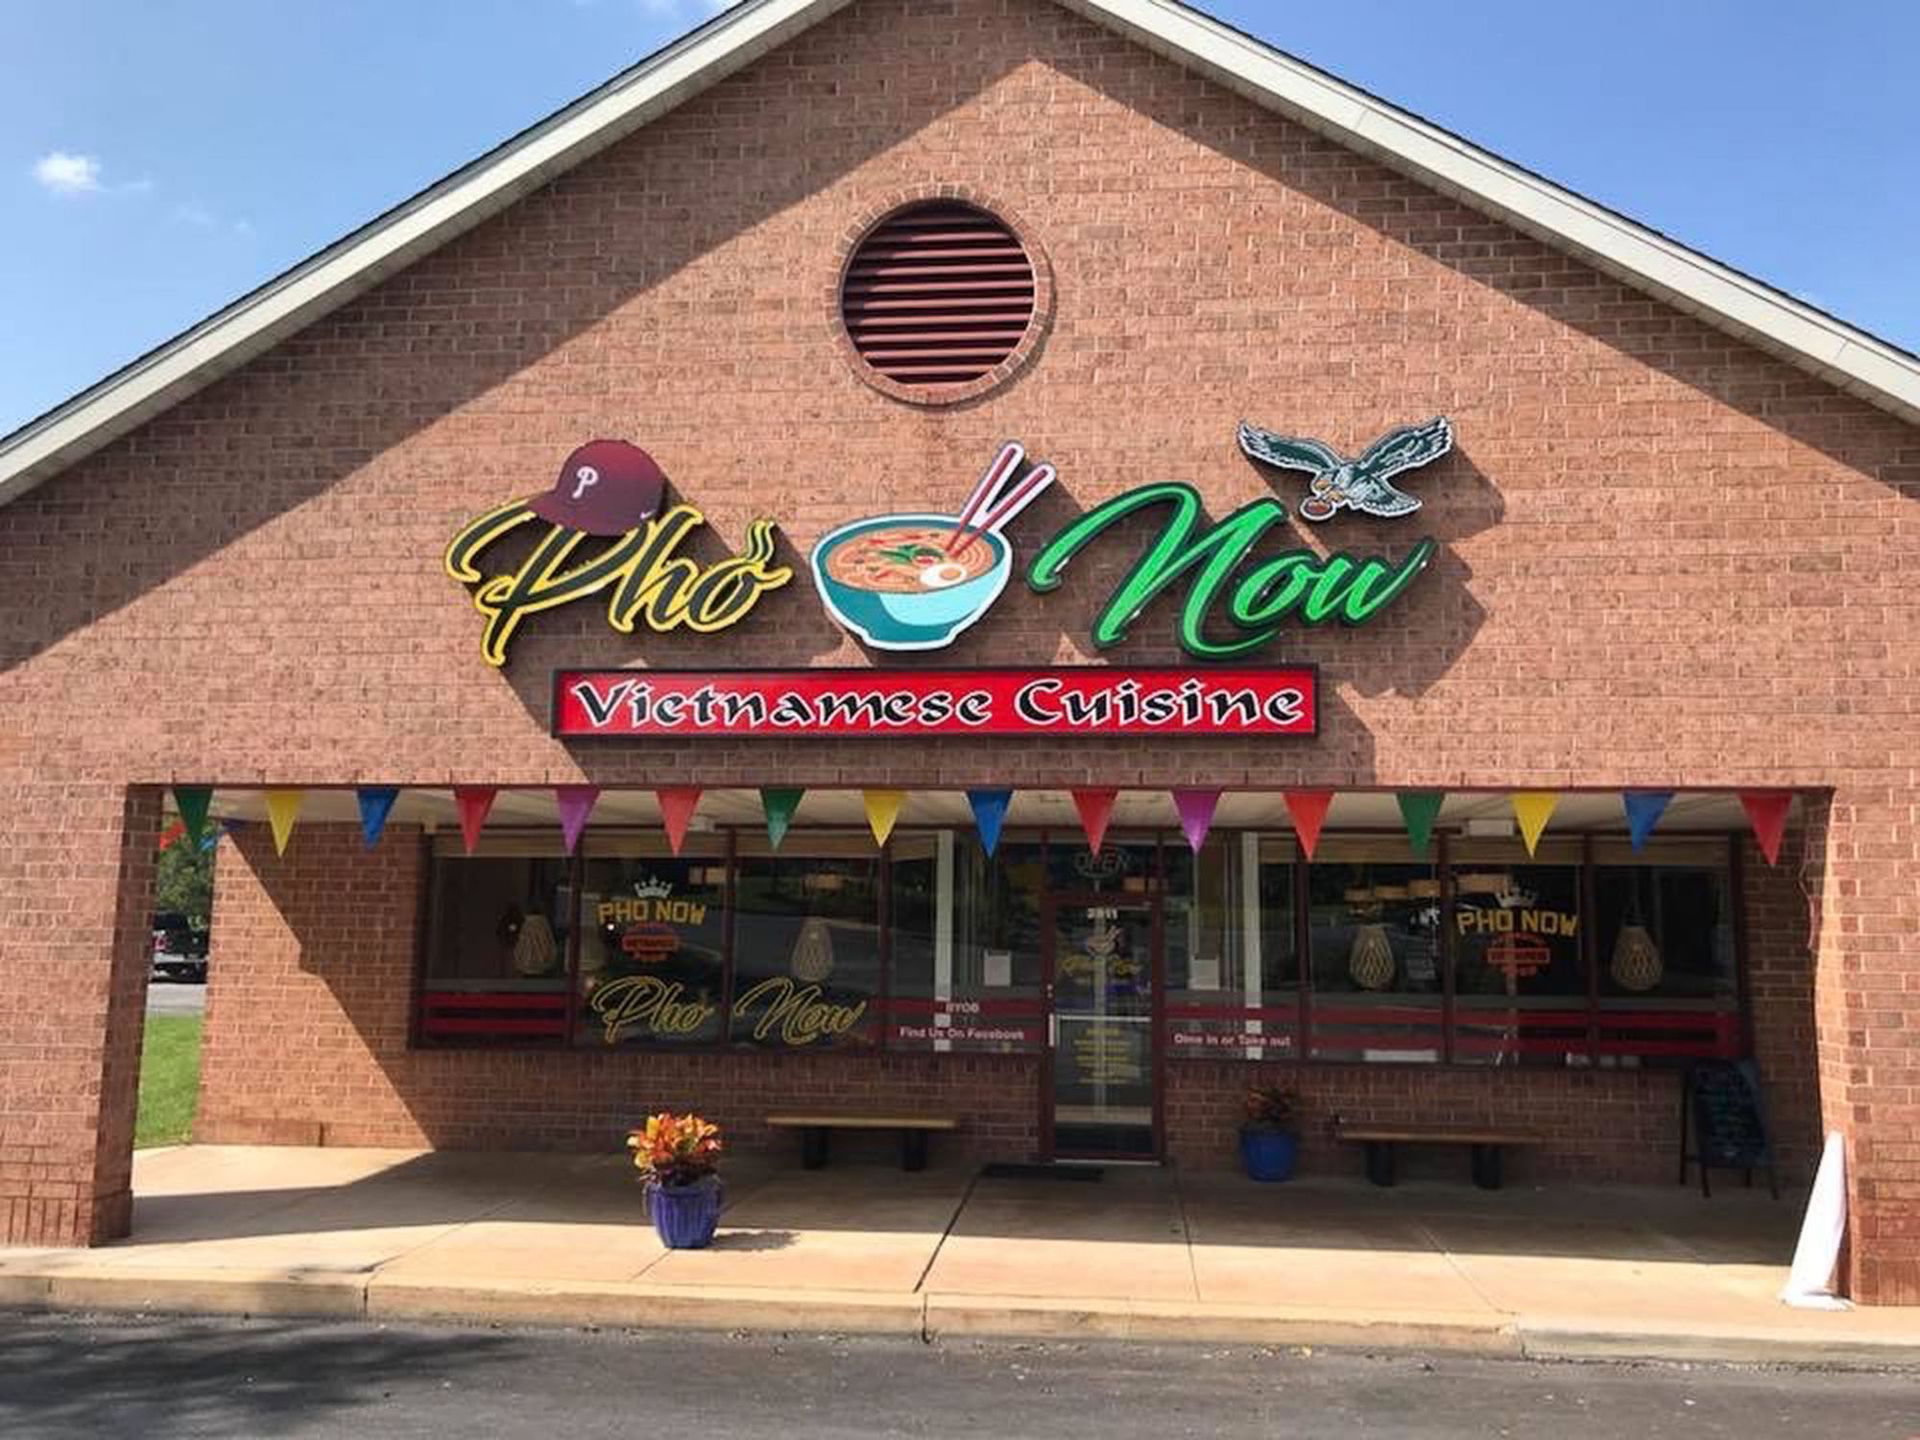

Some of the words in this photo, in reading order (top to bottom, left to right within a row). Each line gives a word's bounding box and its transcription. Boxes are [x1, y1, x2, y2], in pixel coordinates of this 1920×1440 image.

[1026, 481, 1438, 661] Now
[571, 679, 993, 728] Vietnamese
[1014, 678, 1305, 727] Cuisine
[597, 900, 649, 925] PHO
[655, 900, 706, 926] NOW
[1456, 909, 1514, 936] PHO
[1520, 909, 1579, 937] NOW
[733, 976, 867, 1045] Now
[899, 1026, 926, 1038] Find
